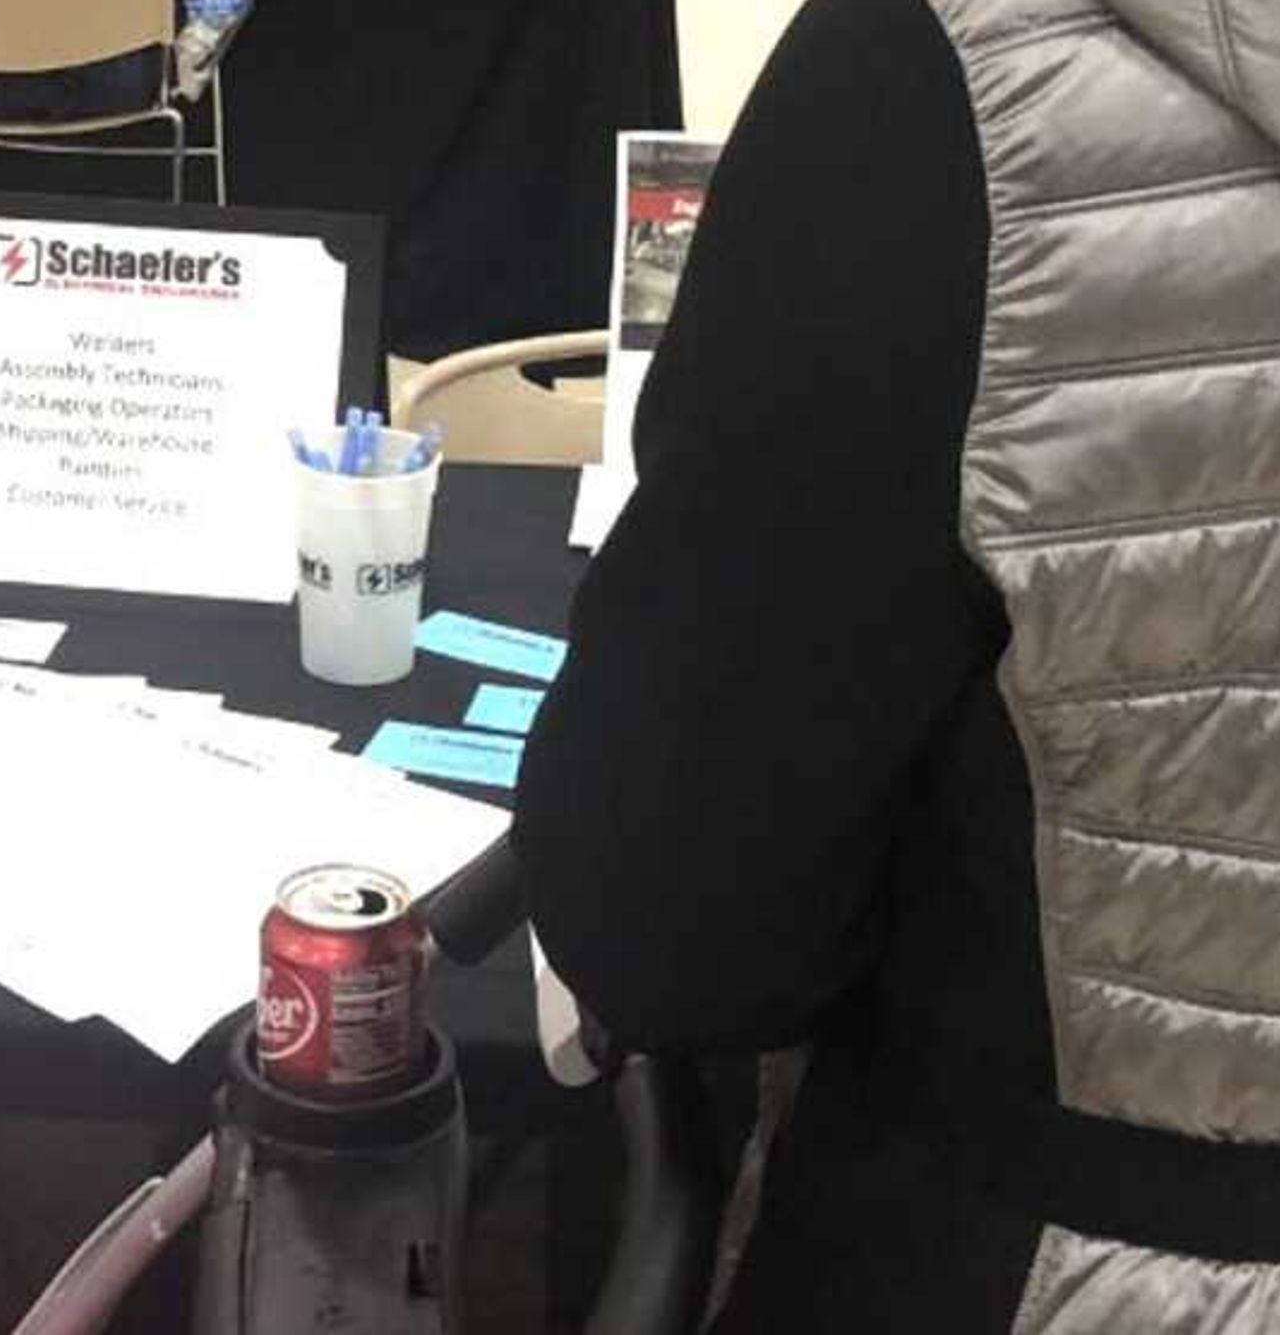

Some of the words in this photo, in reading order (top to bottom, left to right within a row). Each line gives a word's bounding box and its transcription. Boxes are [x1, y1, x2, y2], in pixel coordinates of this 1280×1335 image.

[46, 240, 241, 286] Schaefer's
[70, 332, 156, 355] Welders
[0, 358, 95, 385] Assembly
